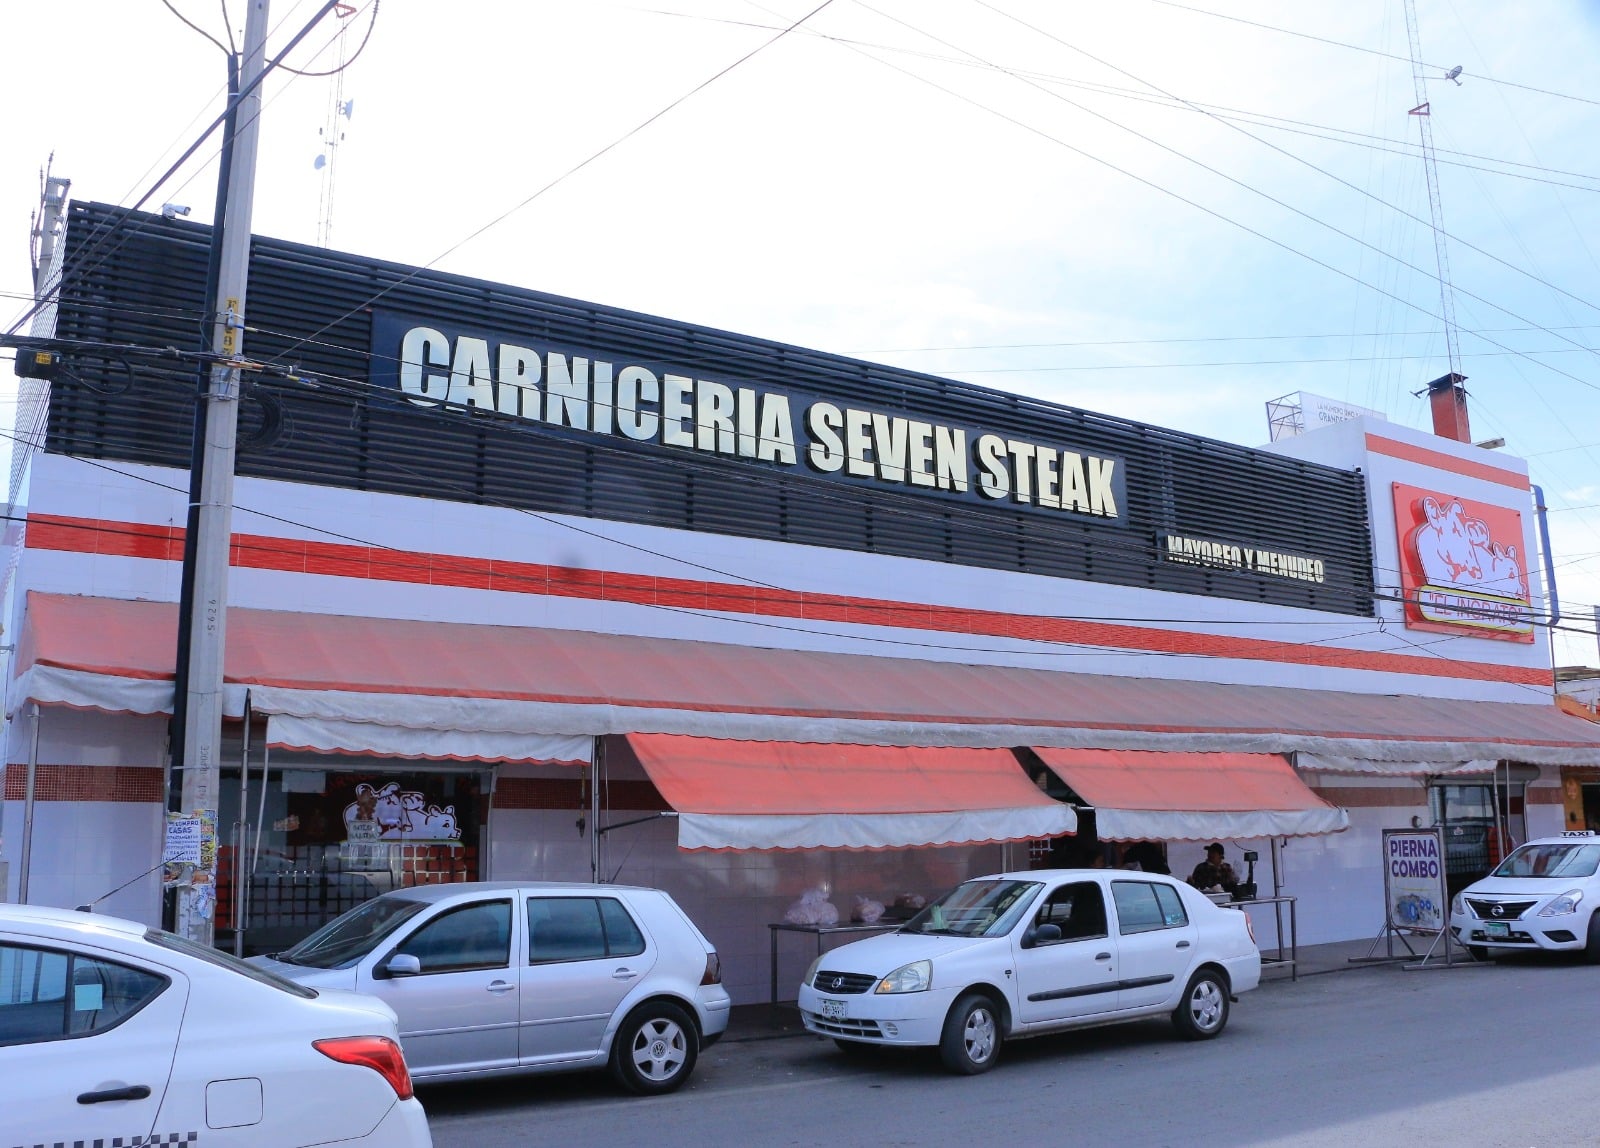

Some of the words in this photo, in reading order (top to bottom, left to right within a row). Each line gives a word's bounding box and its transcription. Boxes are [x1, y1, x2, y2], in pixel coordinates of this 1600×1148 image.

[400, 326, 797, 465] CARNICERIA
[809, 401, 968, 492] SEVEN
[977, 434, 1118, 518] STEAK
[1167, 535, 1242, 570] MAYOREO
[1244, 548, 1253, 569] Y
[1256, 550, 1324, 584] MENUDEO
[1390, 839, 1438, 858] PIERNA
[1391, 860, 1439, 879] COMBO
